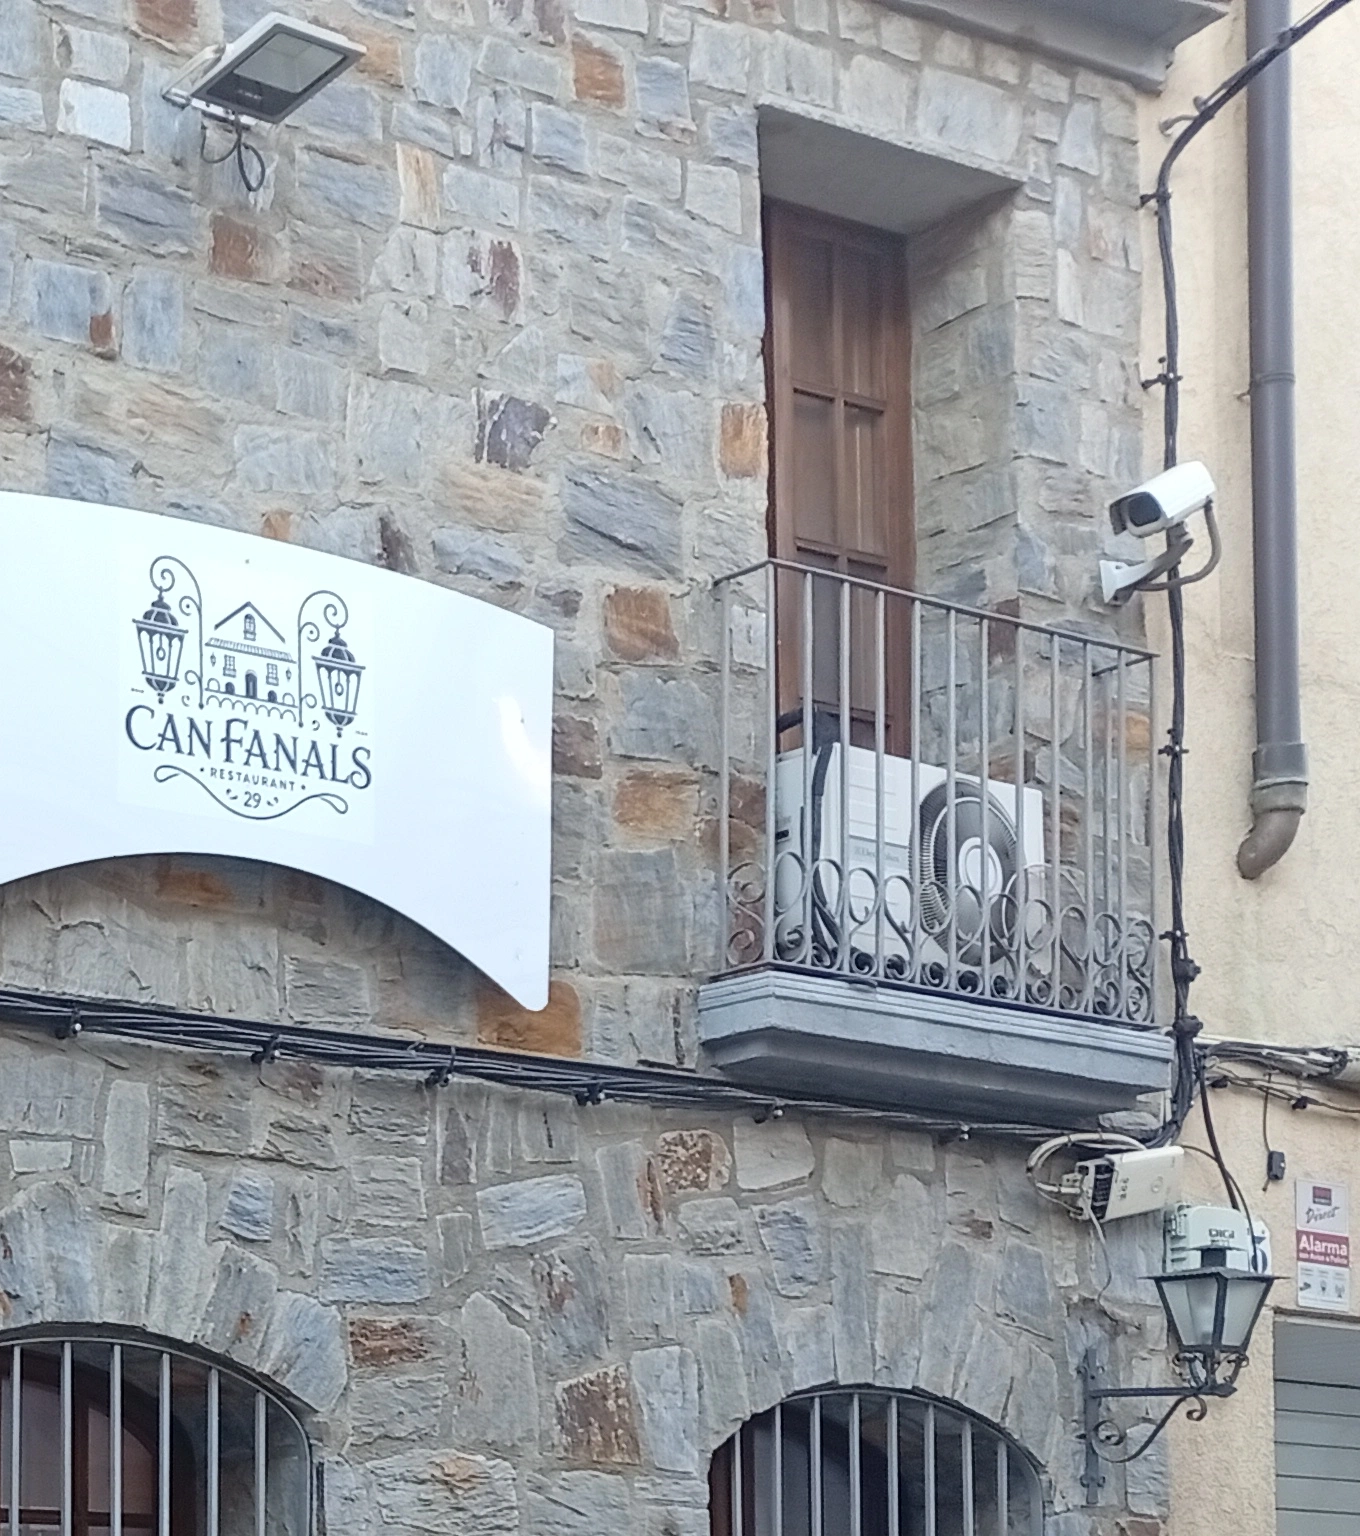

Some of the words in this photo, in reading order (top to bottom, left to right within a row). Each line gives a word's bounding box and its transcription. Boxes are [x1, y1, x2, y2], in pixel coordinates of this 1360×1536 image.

[124, 704, 214, 760] CAN
[220, 718, 372, 790] FANALS
[210, 766, 296, 792] RESTAURANT
[243, 791, 262, 809] 29
[1299, 1234, 1348, 1256] Alarma
